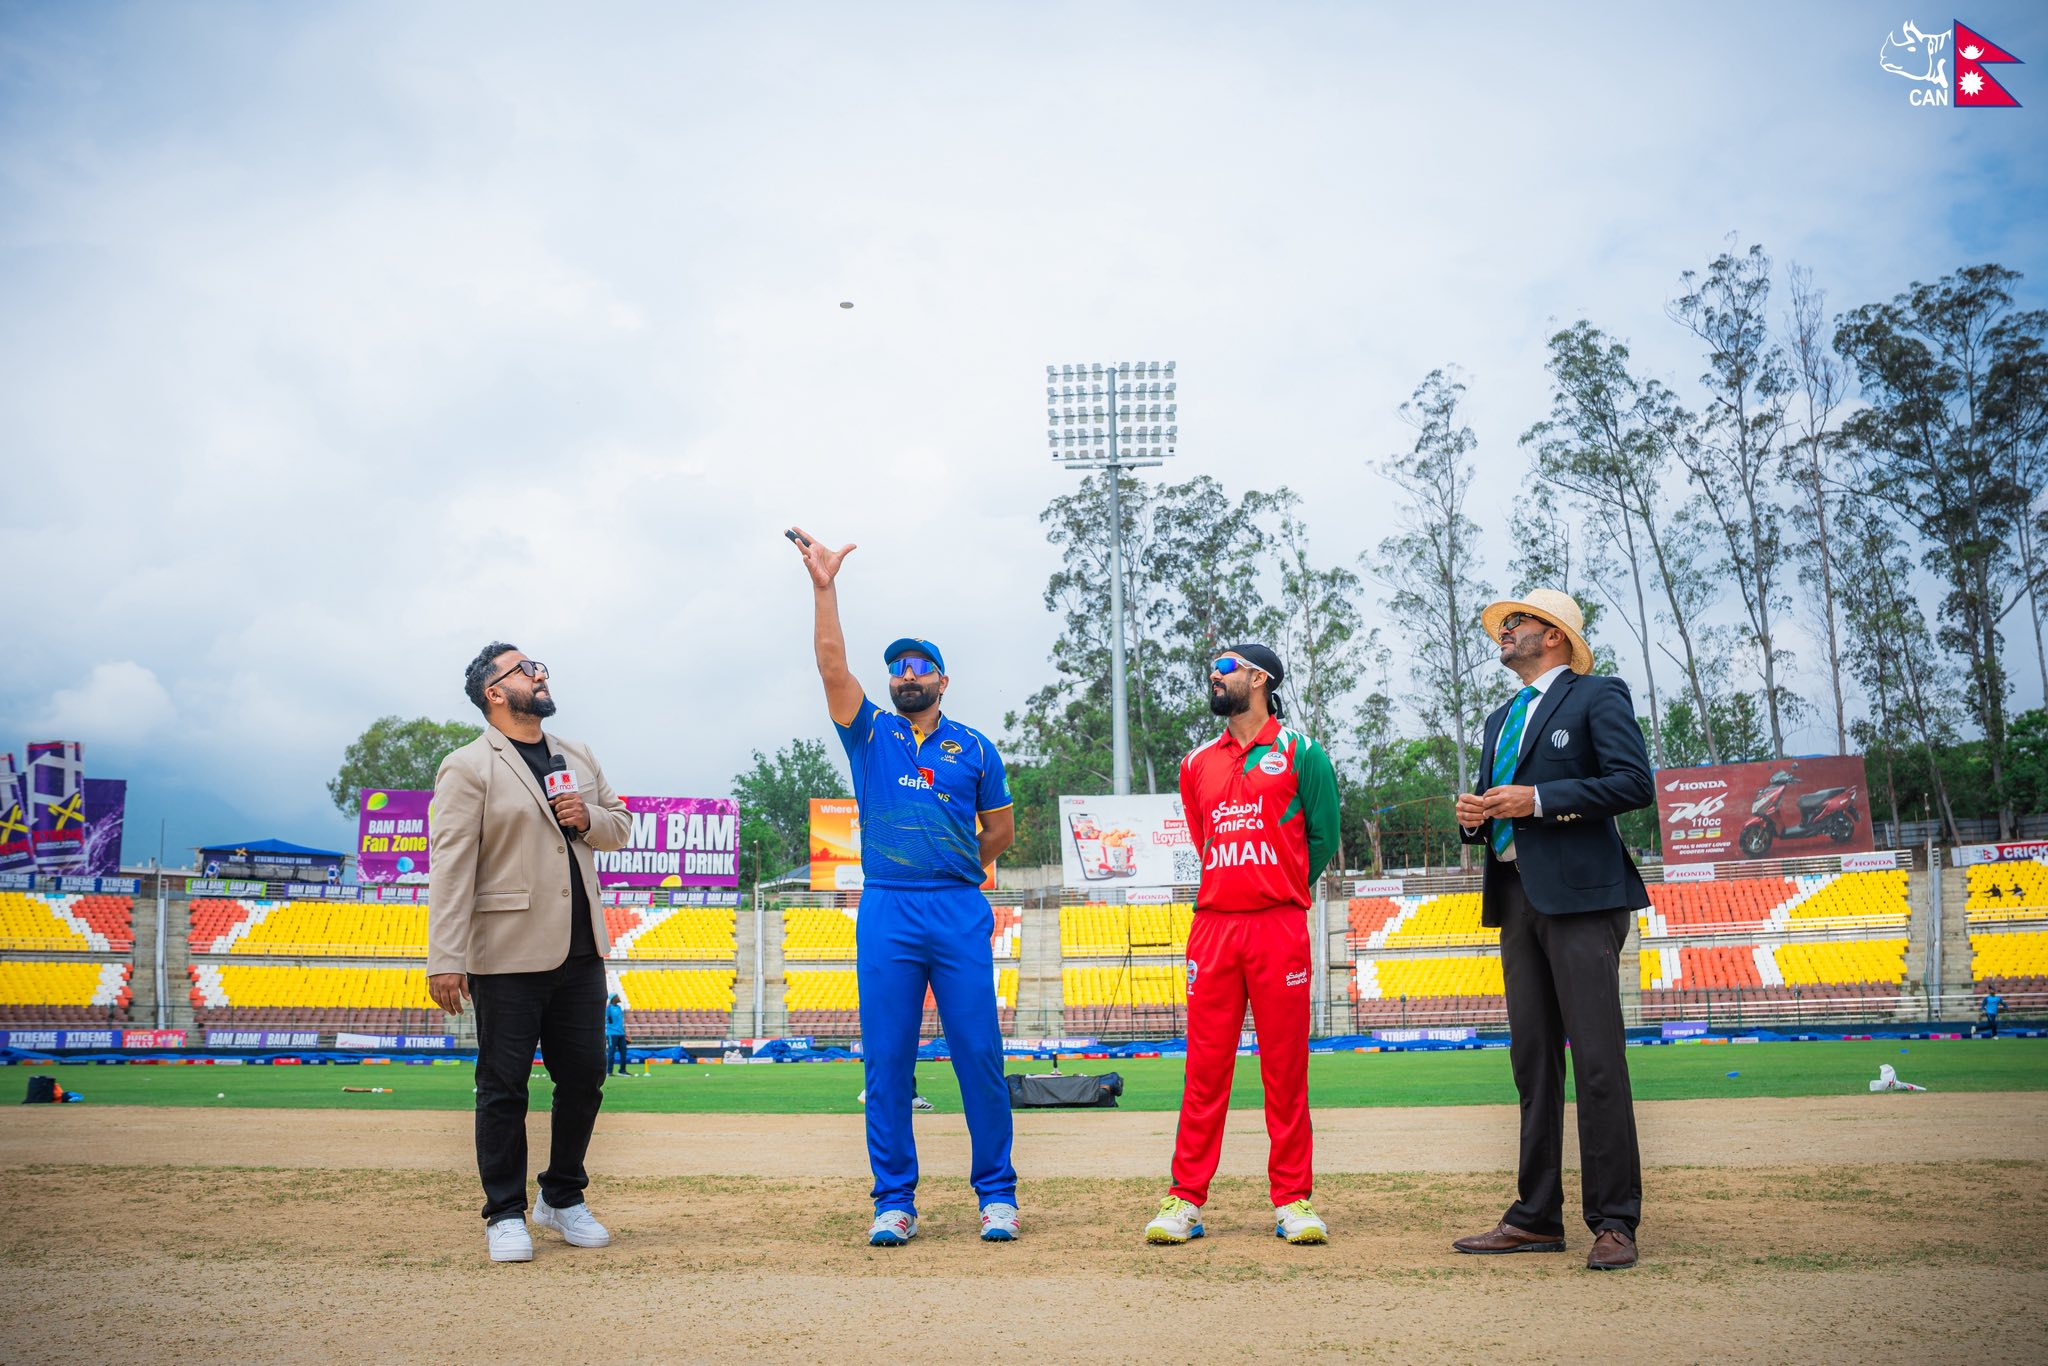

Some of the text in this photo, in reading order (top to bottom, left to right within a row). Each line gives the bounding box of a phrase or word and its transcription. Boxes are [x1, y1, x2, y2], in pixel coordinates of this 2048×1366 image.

[1679, 780, 1728, 791] HONDA
[820, 804, 853, 814] Where
[368, 819, 423, 834] BAM BAM
[1691, 817, 1722, 828] 110cc
[666, 814, 736, 851] BAM
[362, 835, 427, 852] Fan Zone
[684, 853, 735, 875] DRINK
[1854, 859, 1894, 867] HONDA
[9, 1031, 113, 1043] XTREME XTREME
[209, 1032, 319, 1046] BAM BAM! BAM BAM!
[1381, 1031, 1421, 1042] XTREME
[404, 1037, 446, 1048] XTREME
